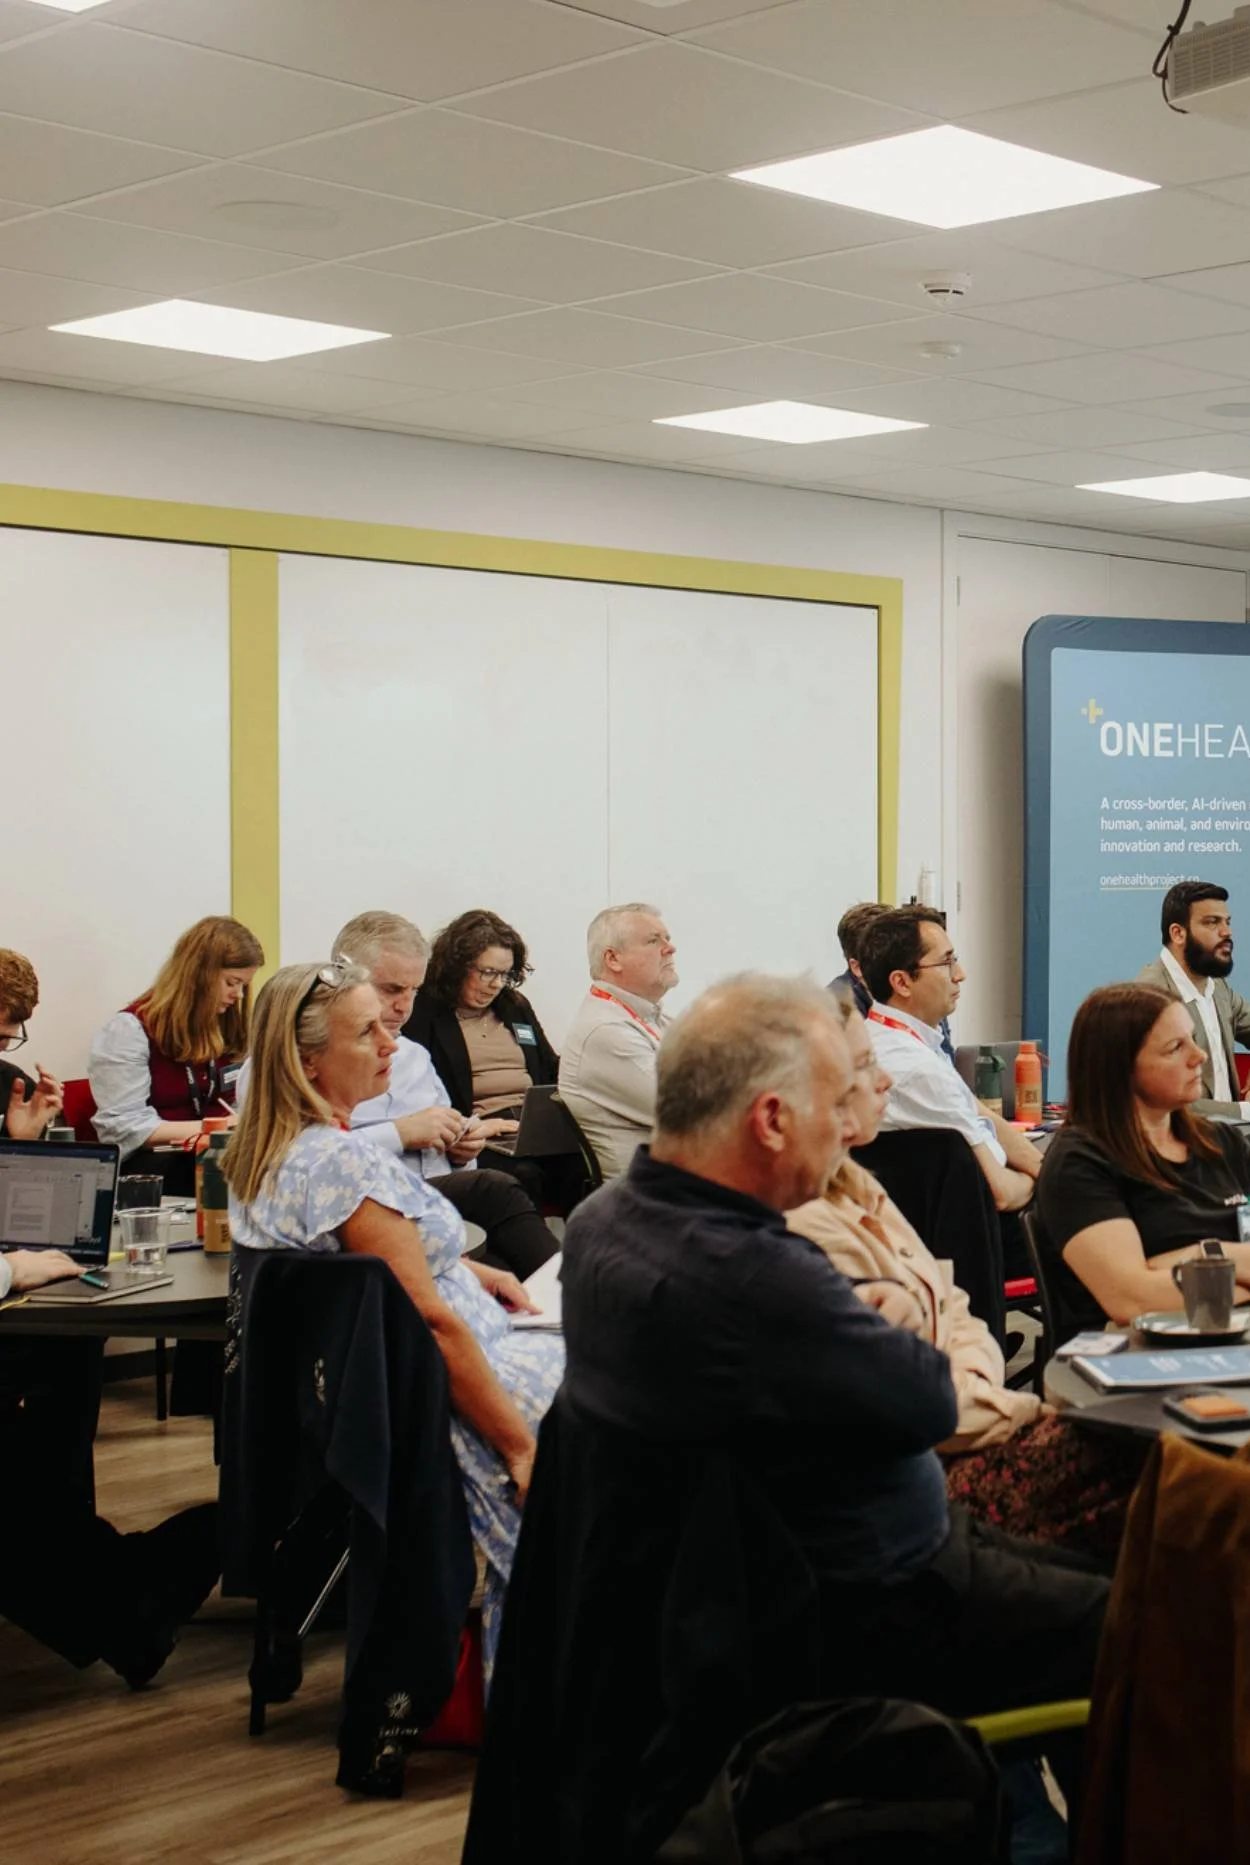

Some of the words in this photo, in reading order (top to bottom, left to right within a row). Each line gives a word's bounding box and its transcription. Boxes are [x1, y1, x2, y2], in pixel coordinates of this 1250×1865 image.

[1100, 797, 1110, 811] A
[1112, 797, 1189, 812] cross-border,
[1191, 797, 1246, 811] AI-driven
[1100, 817, 1143, 832] human,
[1145, 817, 1187, 832] animal,
[1190, 817, 1212, 831] and
[1100, 839, 1161, 853] innovation
[1162, 839, 1186, 853] and
[1187, 839, 1243, 853] research.
[1099, 871, 1201, 888] onehealthprojectco
